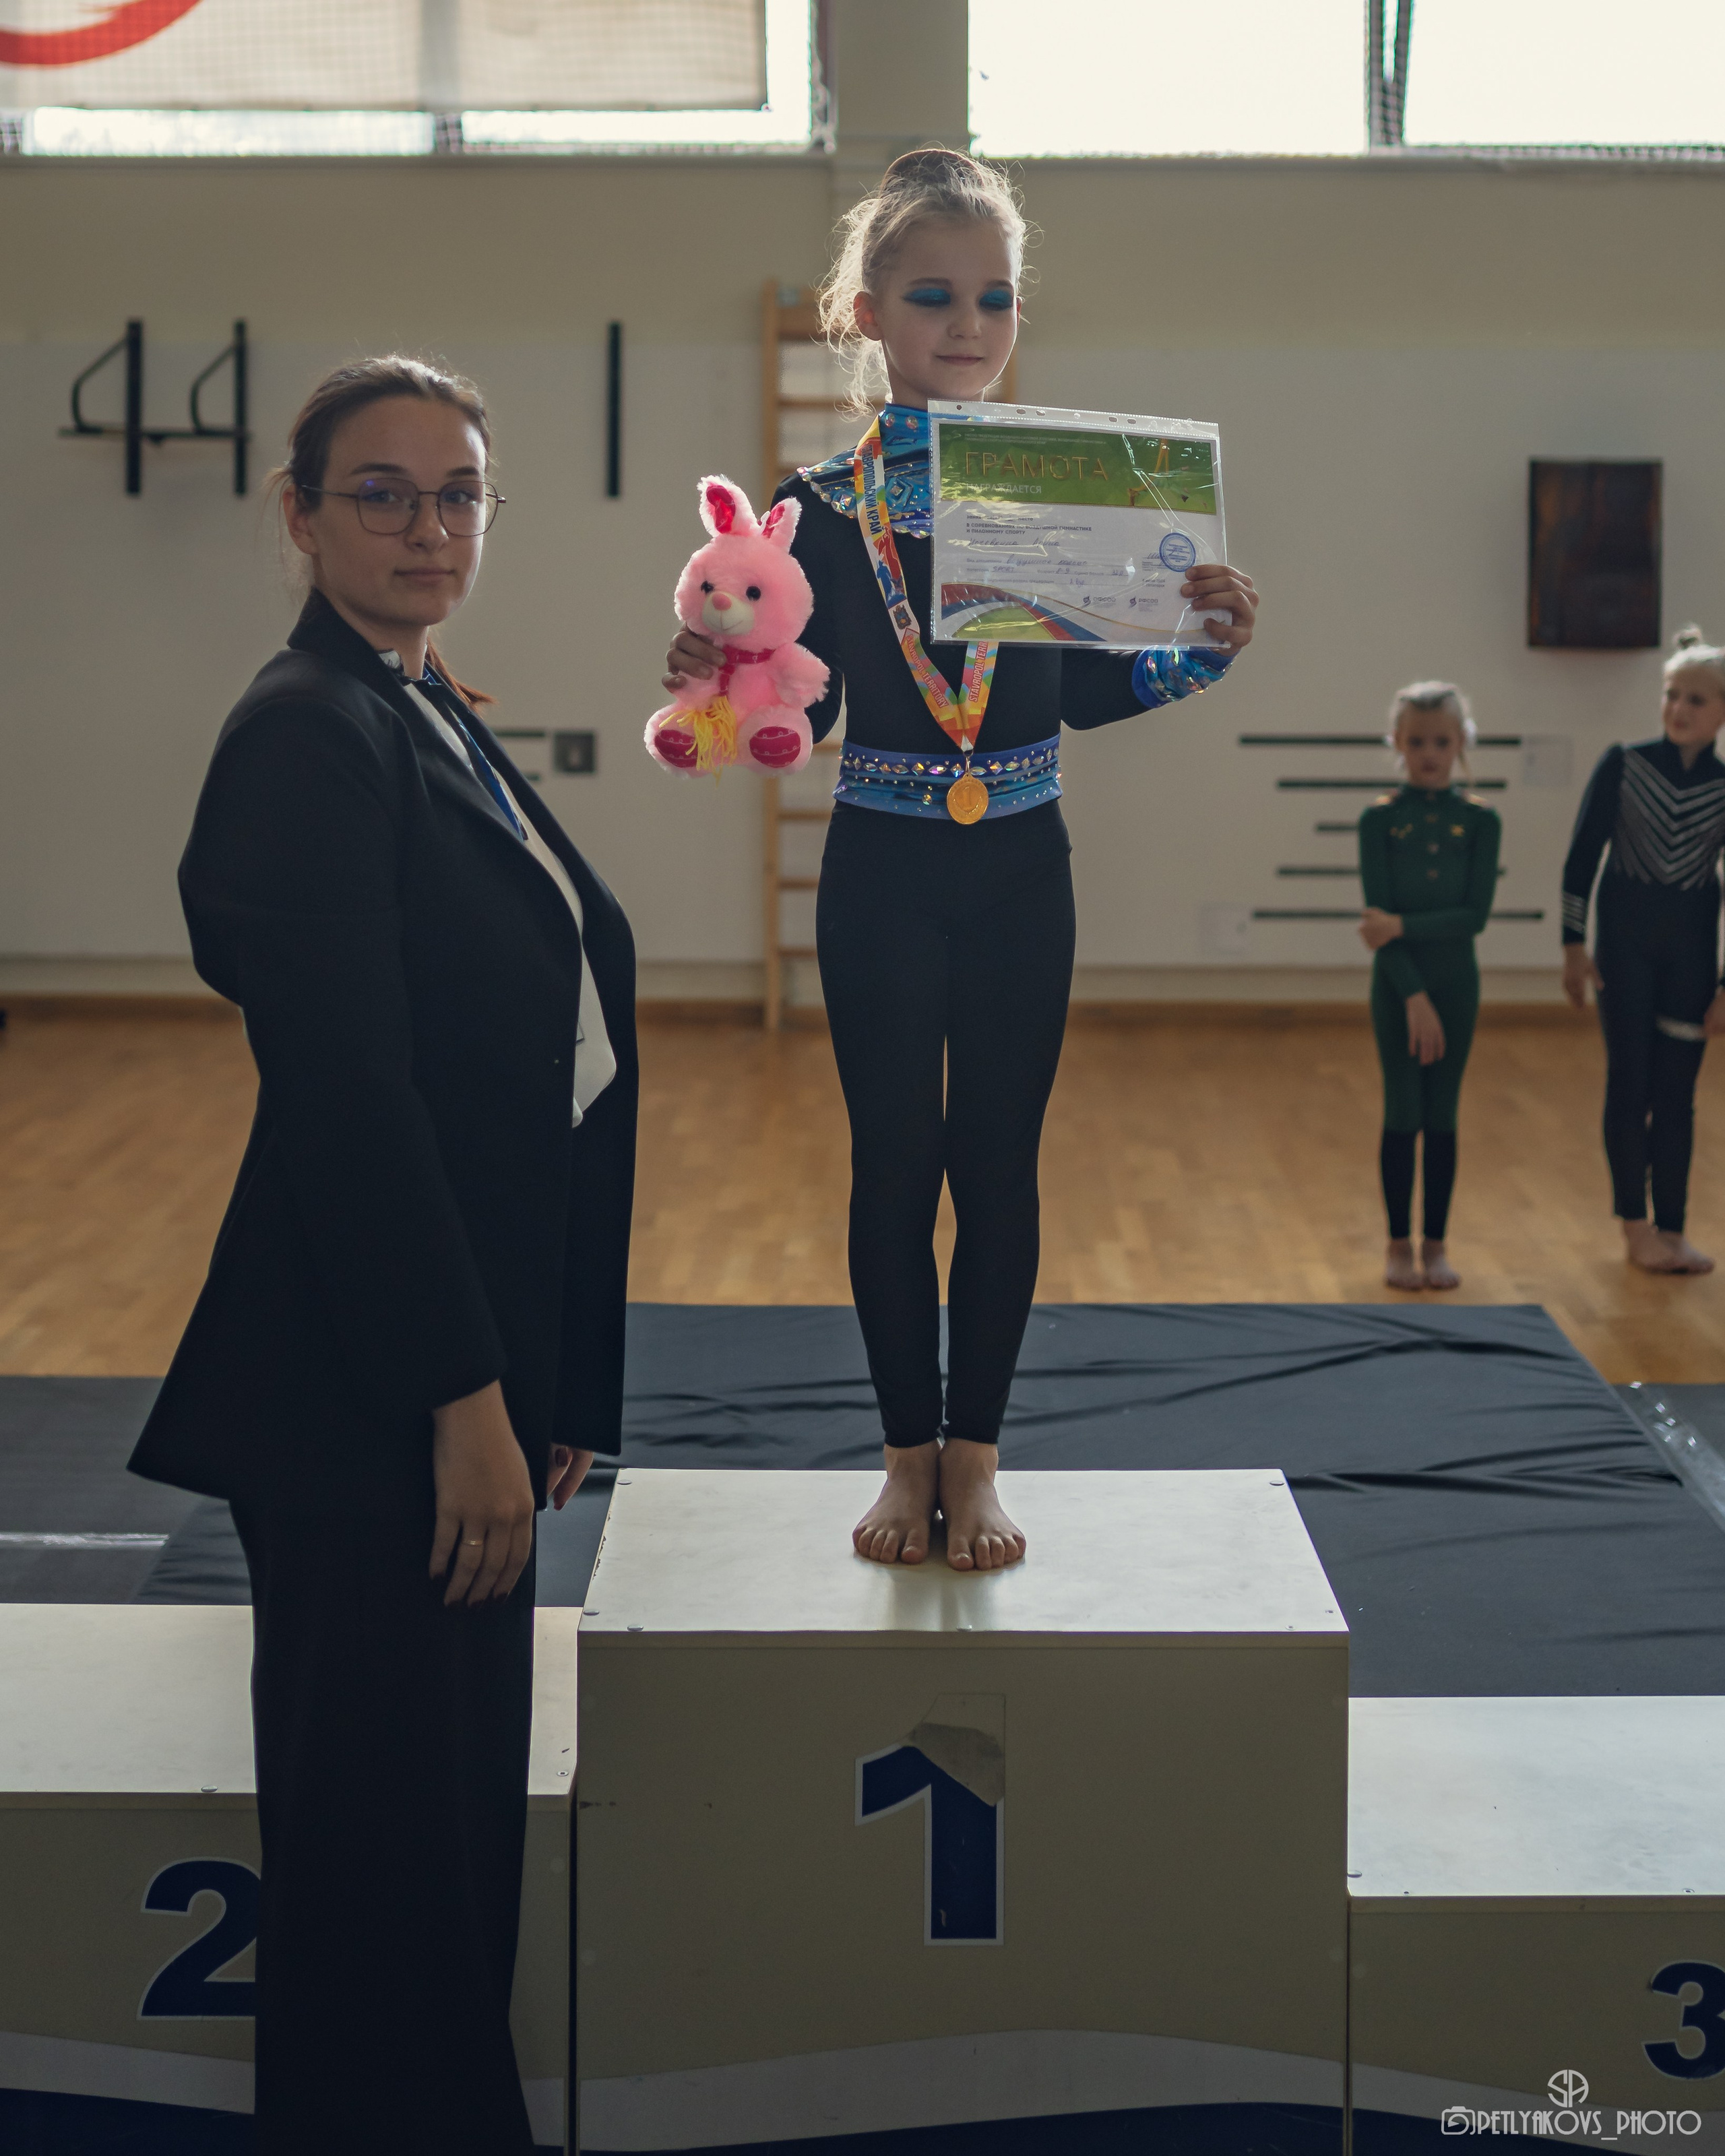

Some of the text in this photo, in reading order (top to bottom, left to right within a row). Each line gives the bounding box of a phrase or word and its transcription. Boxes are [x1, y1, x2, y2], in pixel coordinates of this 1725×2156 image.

[862, 444, 885, 535] СТАВРОПОЛЬСКИЙ КРАЙ
[966, 451, 1108, 480] ГРАМОТА
[966, 483, 1042, 494] НАГРАЖДАЕТСЯ
[906, 634, 949, 708] STAVROPOL TERRITORY
[969, 661, 984, 703] STAVROPOL
[855, 1744, 1004, 1946] 1
[140, 1857, 260, 2020] 2
[1643, 1960, 1725, 2080] 3
